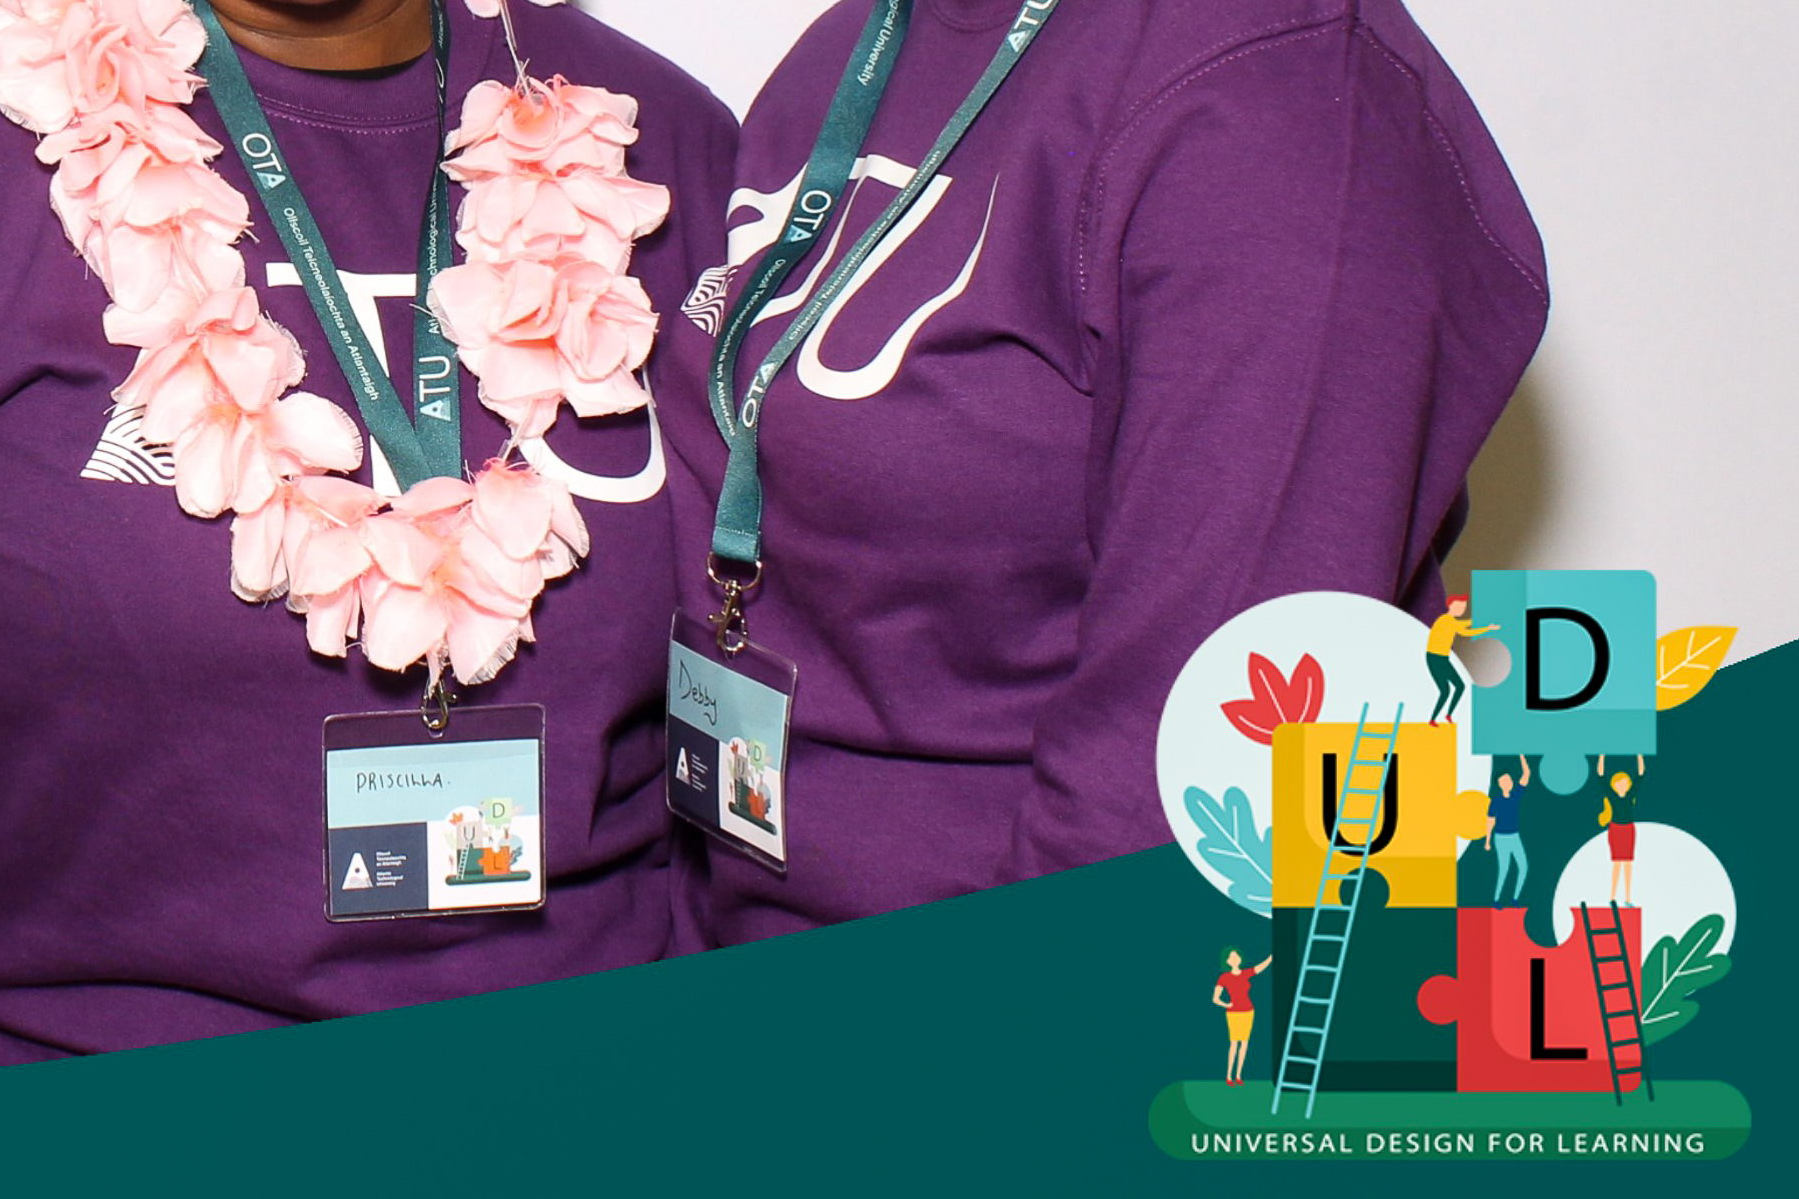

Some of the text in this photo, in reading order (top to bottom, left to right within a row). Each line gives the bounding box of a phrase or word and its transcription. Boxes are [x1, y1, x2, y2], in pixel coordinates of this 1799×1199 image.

[857, 27, 894, 86] University
[283, 207, 308, 247] Ollscoil
[348, 343, 380, 402] Atlantaigh
[419, 355, 452, 422] ATU
